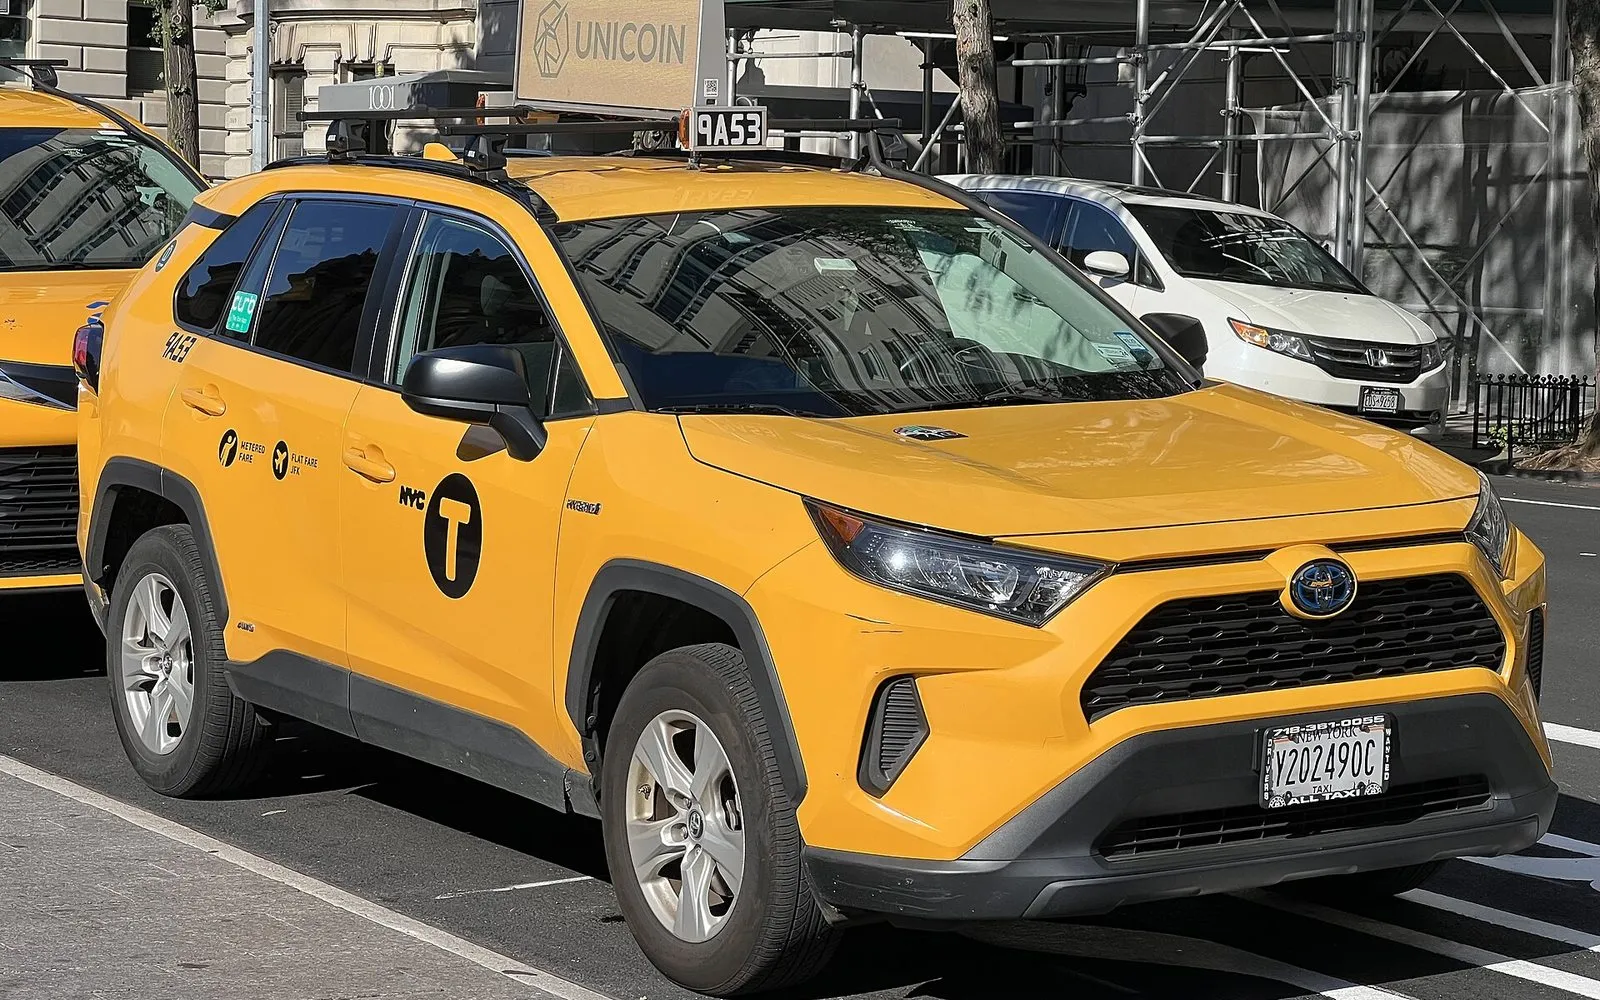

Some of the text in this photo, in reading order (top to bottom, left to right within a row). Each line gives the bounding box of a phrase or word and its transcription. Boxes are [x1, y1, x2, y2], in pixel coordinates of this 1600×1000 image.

[575, 21, 686, 64] UNICOIN
[368, 85, 395, 110] 1001
[698, 113, 761, 146] 9A53
[231, 295, 256, 315] curb
[162, 331, 197, 363] 9A53
[238, 452, 254, 463] FARE
[240, 440, 266, 454] METERED
[290, 466, 301, 475] JFK
[291, 453, 318, 468] FLAT FARE
[399, 485, 471, 581] NYC T
[1273, 715, 1385, 737] 718-381-0055
[1297, 726, 1358, 745] NEW YORK
[1276, 739, 1375, 787] Y202490C
[1383, 728, 1392, 781] WANTED
[1287, 795, 1319, 805] ALL
[1322, 789, 1360, 800] TAXI
[1312, 784, 1333, 795] TAXI
